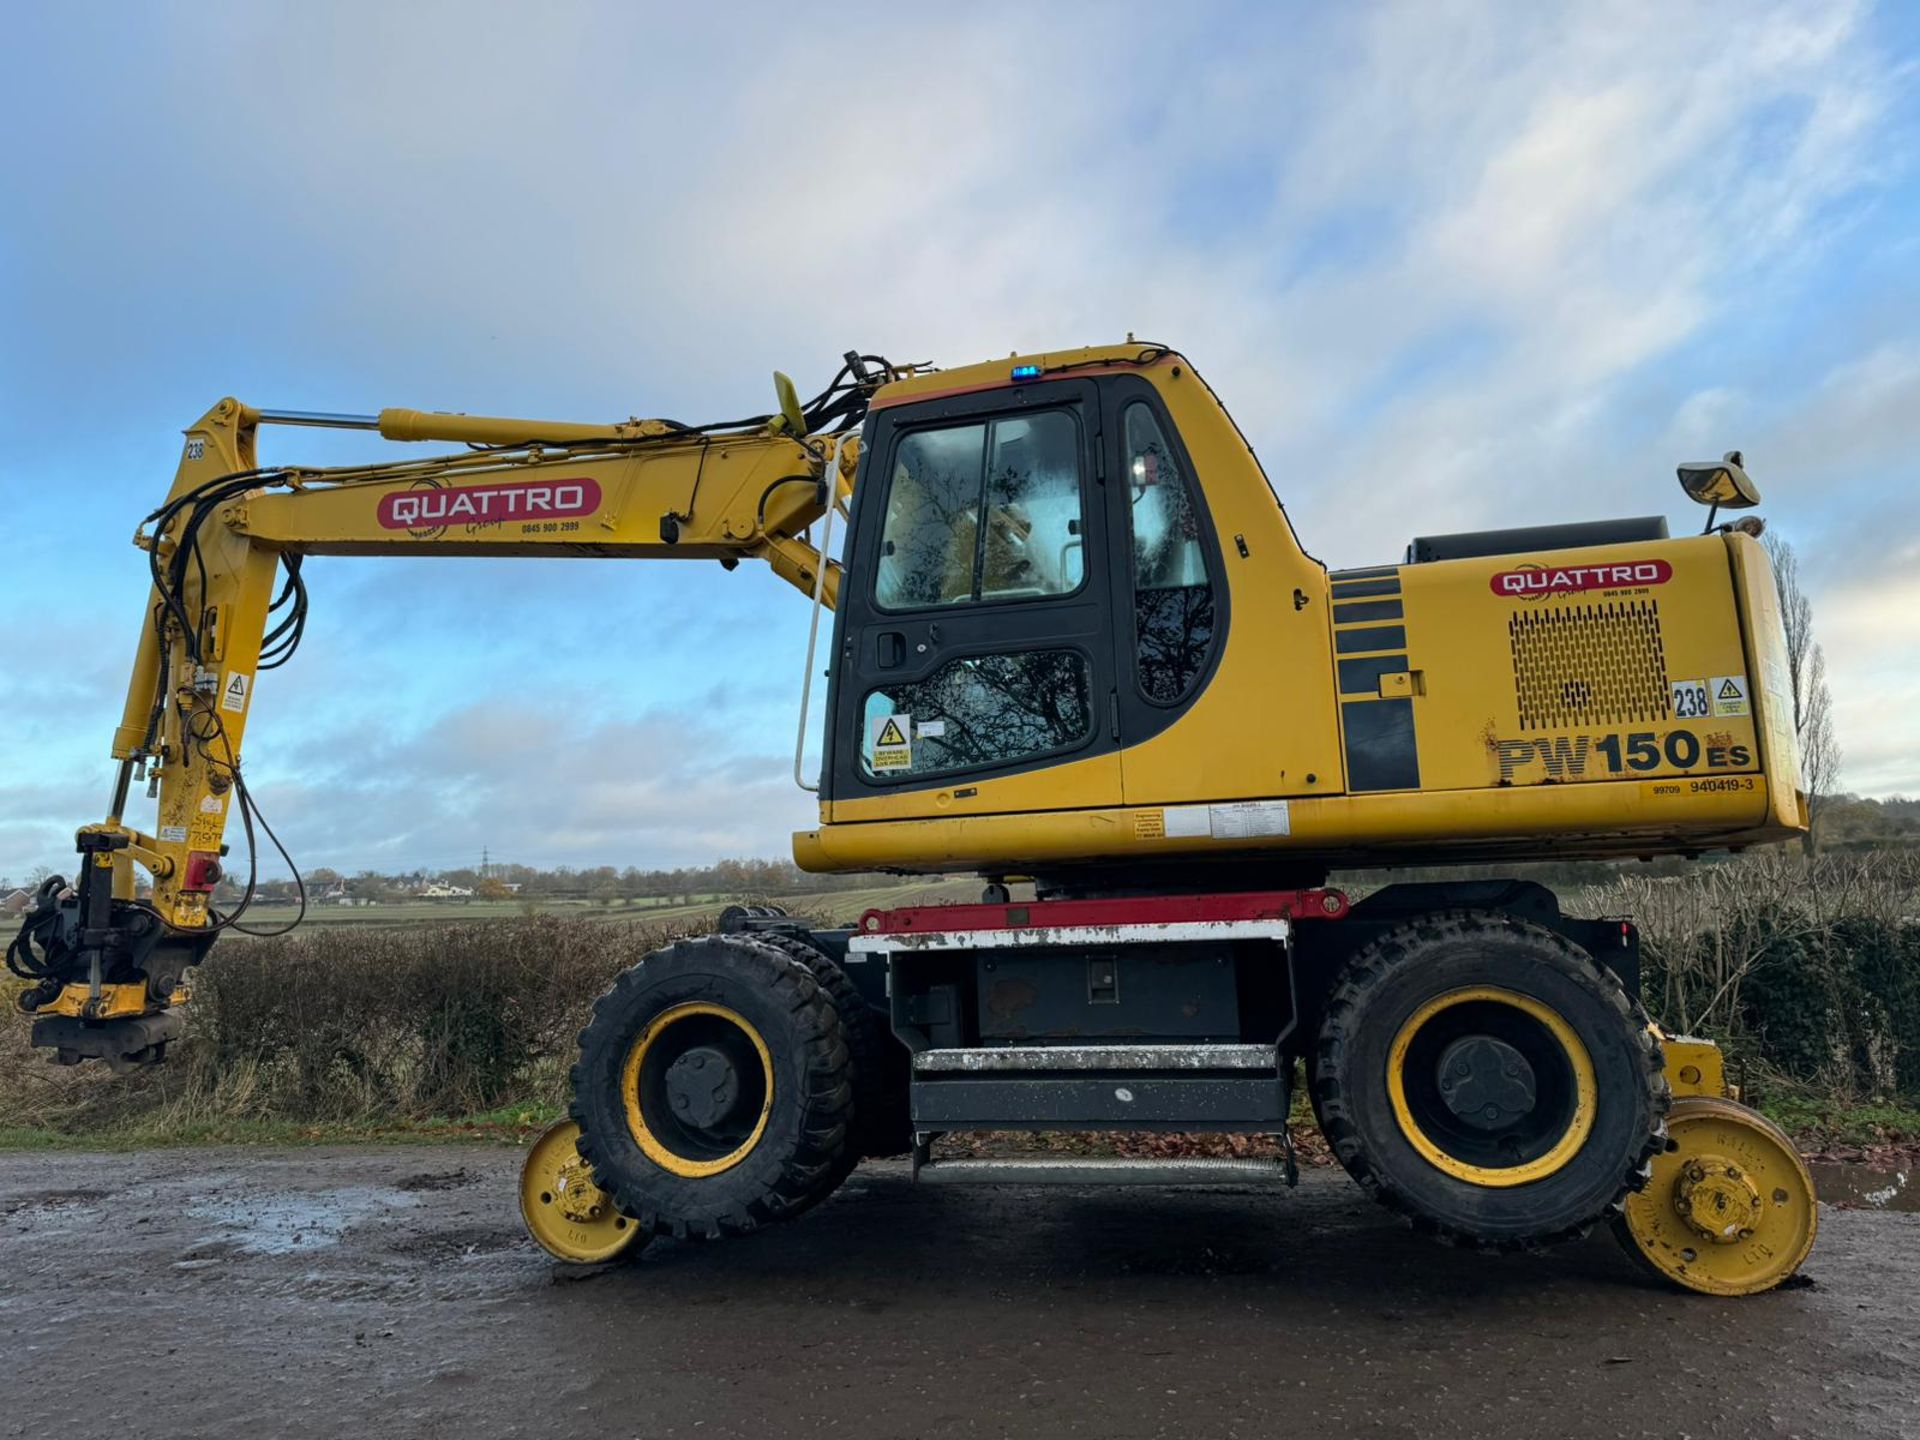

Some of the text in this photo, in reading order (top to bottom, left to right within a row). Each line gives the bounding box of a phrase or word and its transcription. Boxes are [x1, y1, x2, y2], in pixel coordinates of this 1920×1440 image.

[188, 443, 204, 459] 238
[392, 485, 584, 525] QUATTRO
[521, 523, 541, 534] 0845
[543, 522, 558, 533] 900
[1503, 564, 1659, 592] QUATTRO
[1674, 687, 1709, 717] 238
[1653, 778, 1755, 795] 99709 940419-3
